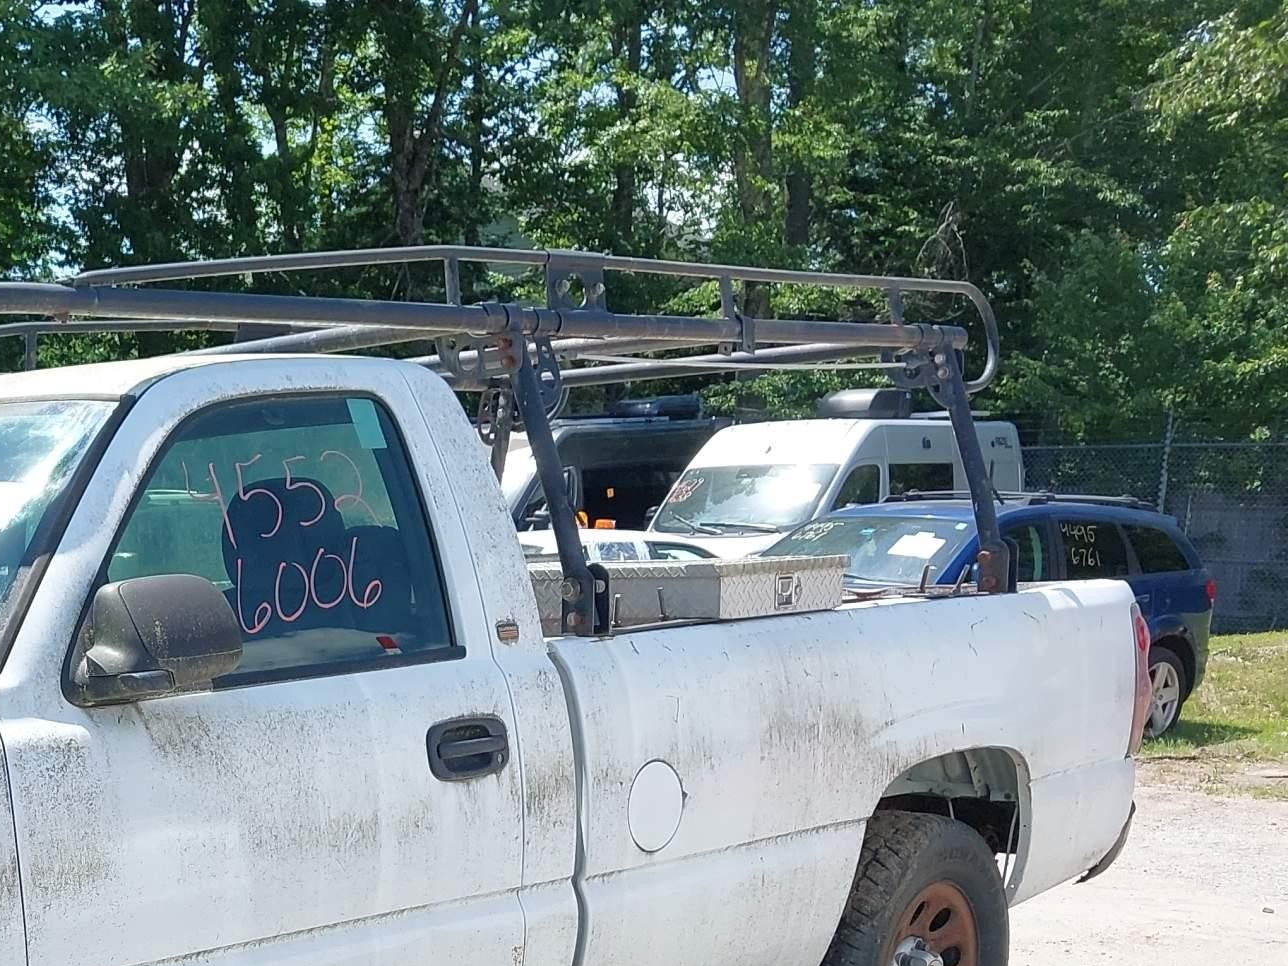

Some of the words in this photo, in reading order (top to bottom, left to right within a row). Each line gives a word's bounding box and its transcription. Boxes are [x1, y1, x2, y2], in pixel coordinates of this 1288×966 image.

[181, 450, 384, 549] 4552
[236, 536, 383, 634] 6006
[1071, 547, 1101, 567] 6761
